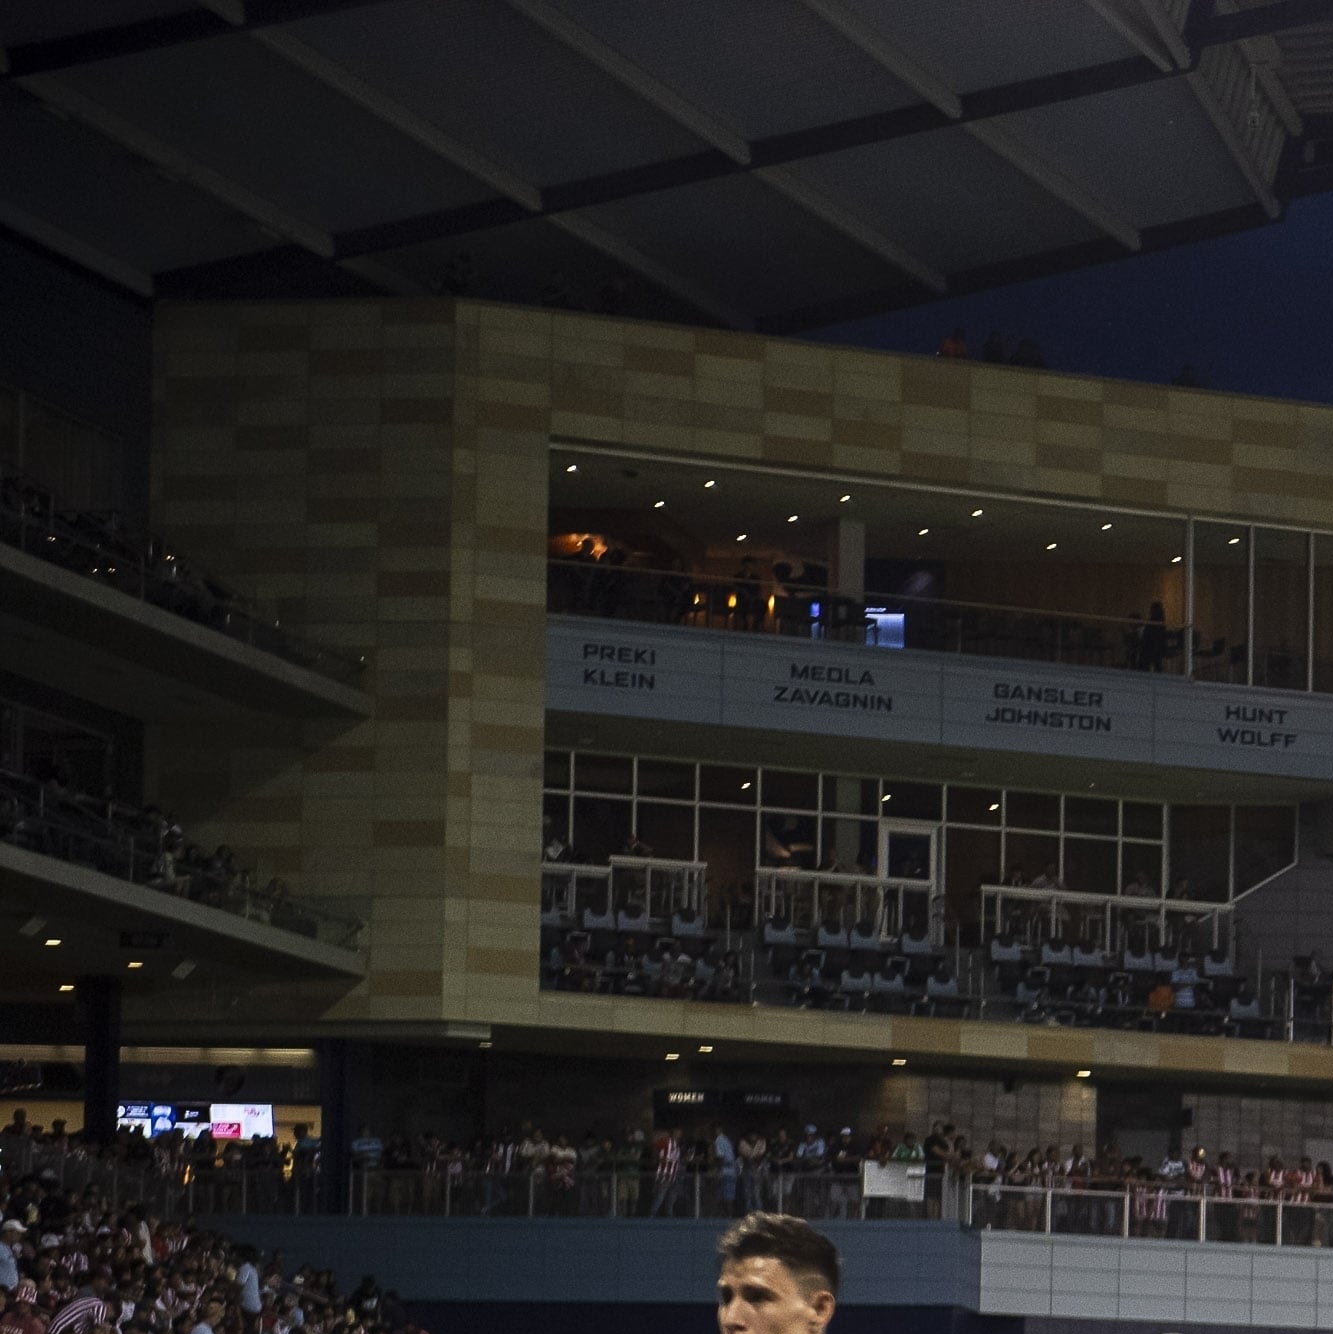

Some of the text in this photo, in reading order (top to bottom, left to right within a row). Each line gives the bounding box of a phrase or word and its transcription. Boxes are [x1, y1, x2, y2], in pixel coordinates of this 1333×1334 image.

[582, 643, 656, 666] PREKI
[582, 667, 656, 691] KLEIN
[790, 662, 875, 687] MEOLA
[772, 685, 894, 712] ZAVAGNIN
[993, 682, 1104, 707] GANSLER
[985, 706, 1111, 733] JOHNSTON
[1225, 704, 1288, 726] HUNT
[1217, 727, 1297, 749] WOLFF
